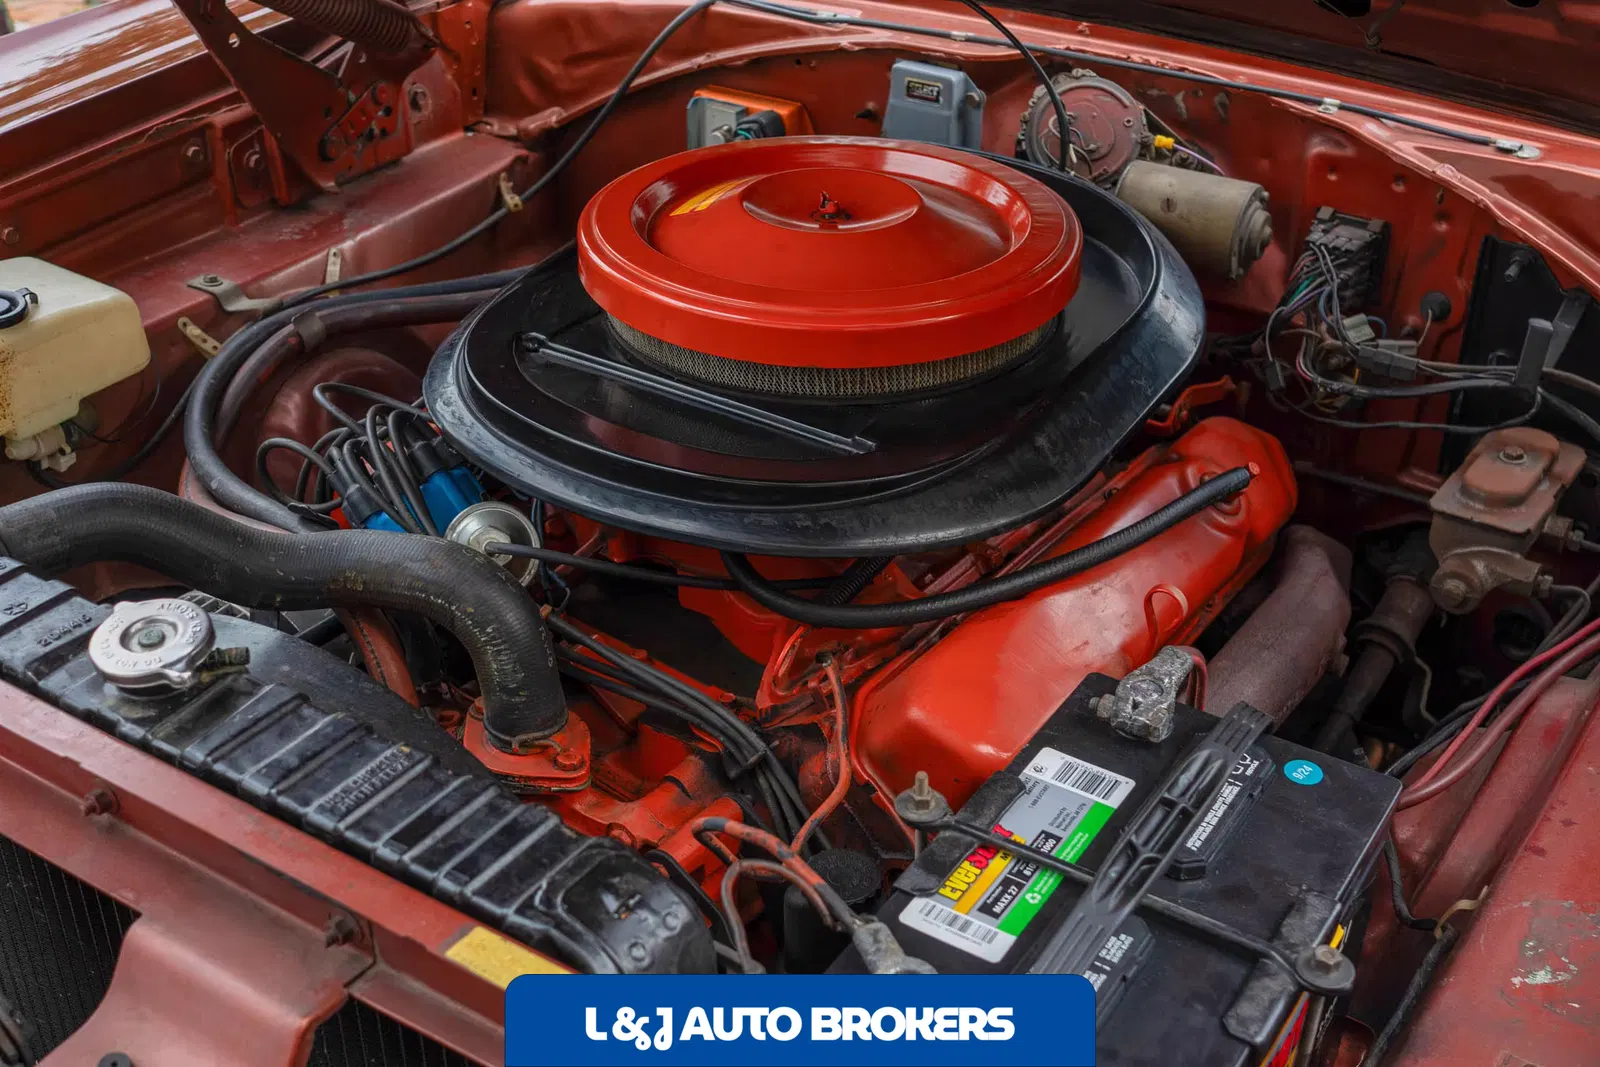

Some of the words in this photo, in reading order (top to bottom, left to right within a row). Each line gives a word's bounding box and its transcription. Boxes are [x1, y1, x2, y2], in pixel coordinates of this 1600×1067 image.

[1292, 765, 1313, 780] 9/24
[992, 892, 1013, 914] MAXX
[1007, 884, 1019, 895] 27
